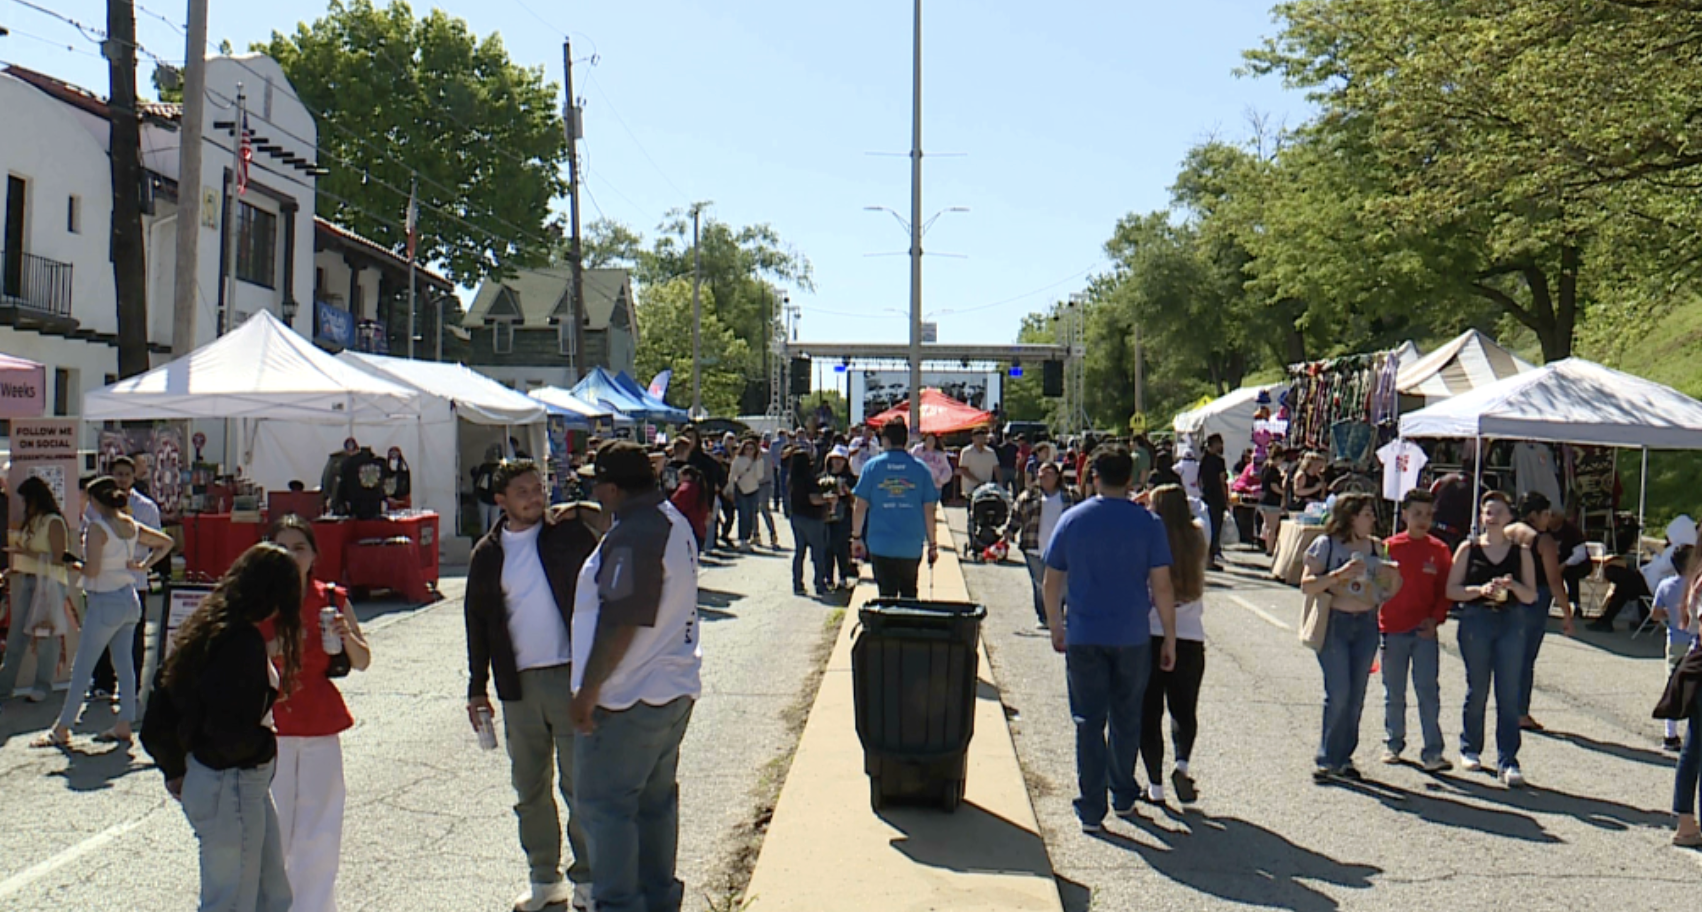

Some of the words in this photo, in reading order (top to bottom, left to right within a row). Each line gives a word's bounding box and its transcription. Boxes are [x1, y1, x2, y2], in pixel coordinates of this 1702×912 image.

[0, 382, 36, 398] Weeks
[16, 427, 56, 436] FOLLOW
[59, 427, 72, 435] ME
[20, 440, 34, 448] ON
[36, 439, 70, 448] SOCIAL
